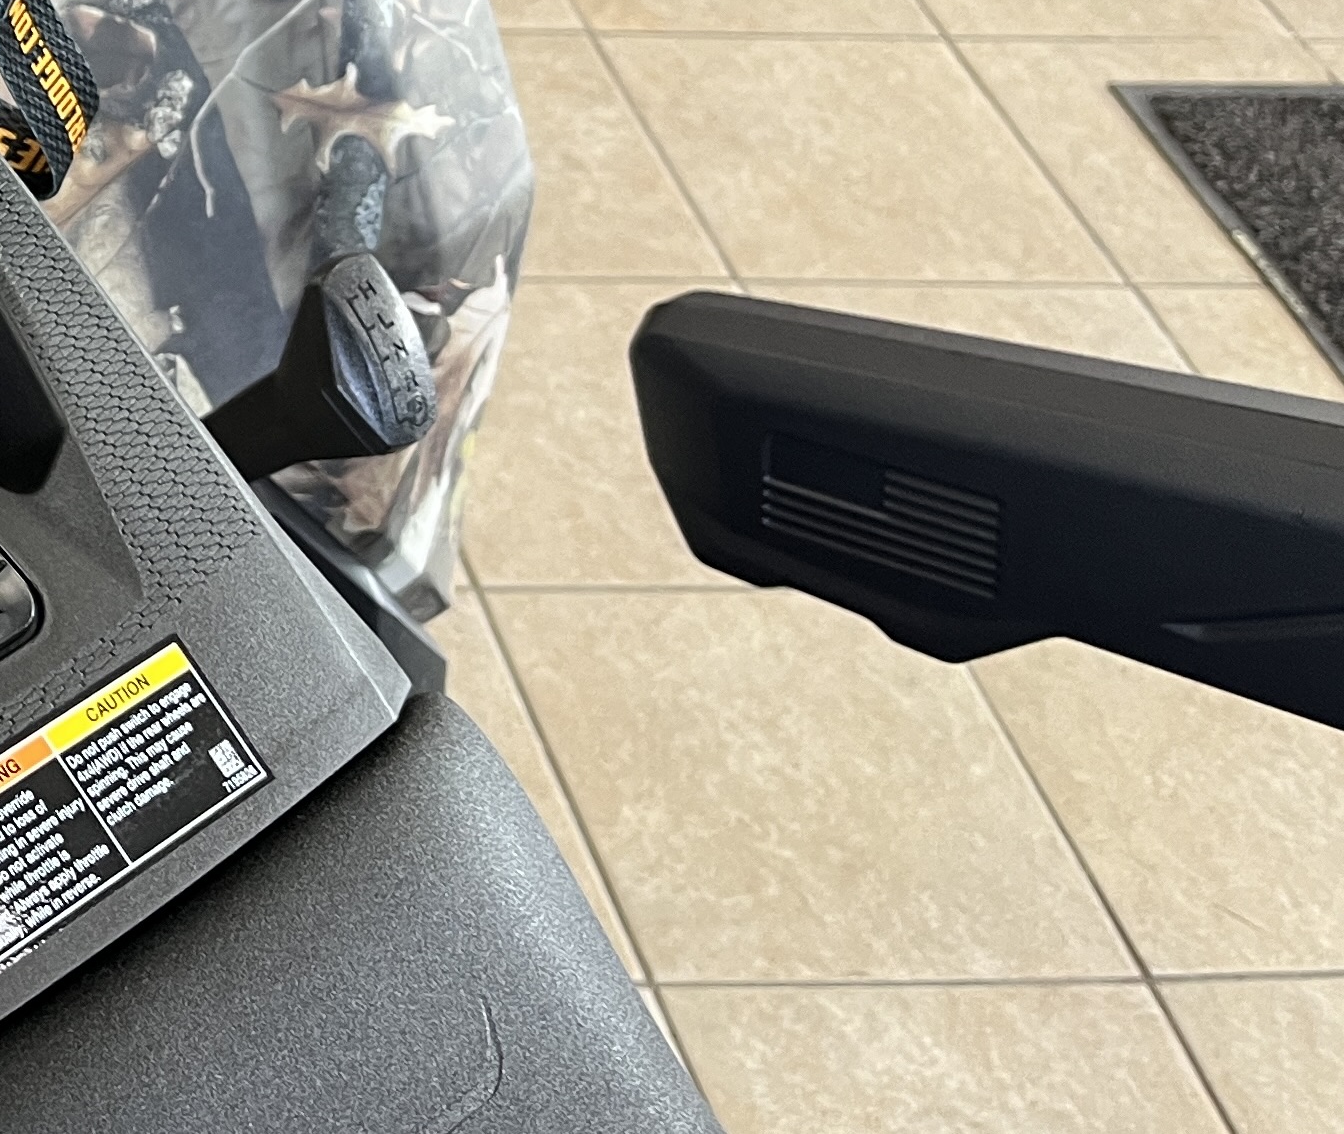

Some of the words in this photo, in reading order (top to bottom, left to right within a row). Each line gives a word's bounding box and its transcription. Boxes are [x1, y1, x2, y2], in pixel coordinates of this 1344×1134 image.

[358, 279, 377, 300] H
[376, 313, 395, 329] L
[86, 674, 151, 722] CAUTION
